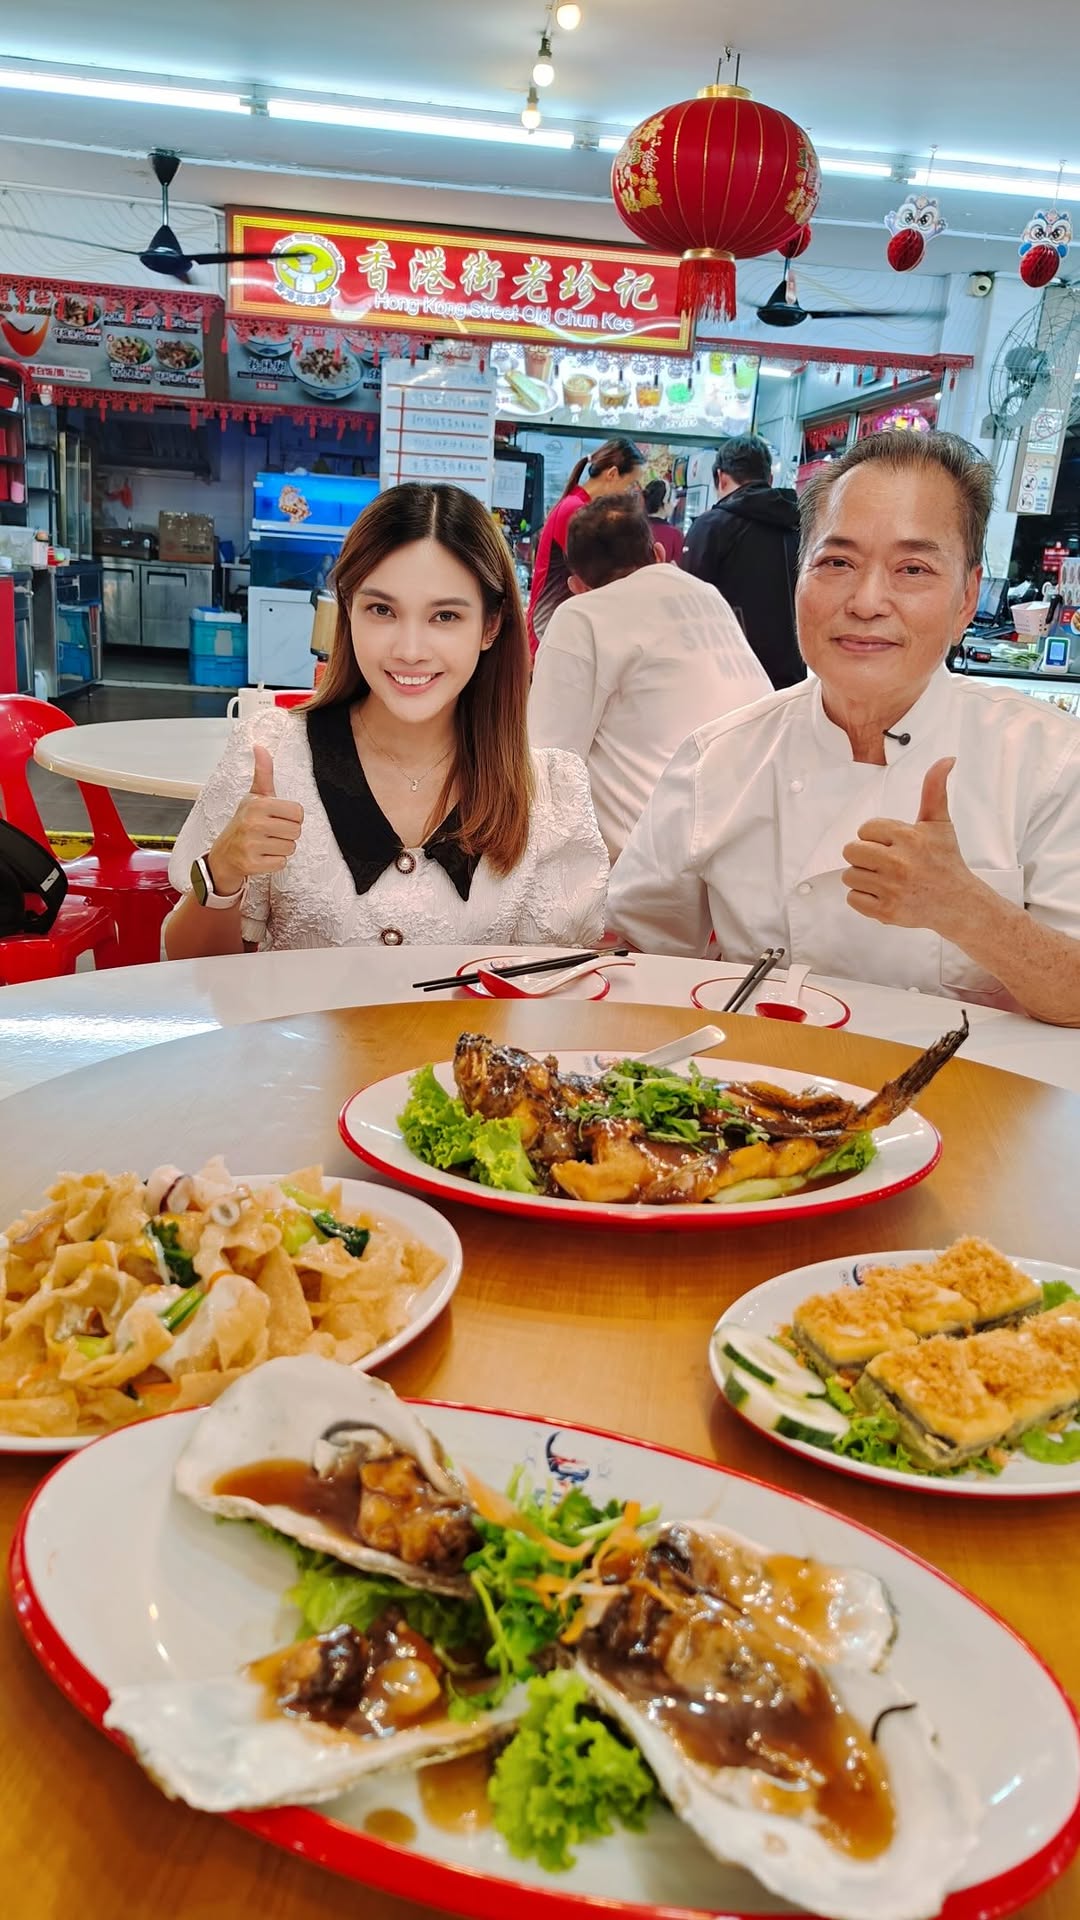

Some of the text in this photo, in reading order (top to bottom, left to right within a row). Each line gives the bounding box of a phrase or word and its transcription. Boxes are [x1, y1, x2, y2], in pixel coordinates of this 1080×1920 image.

[356, 239, 660, 312] 香港街老珍记
[374, 292, 635, 331] Hong Kong Street Old Chun Kee
